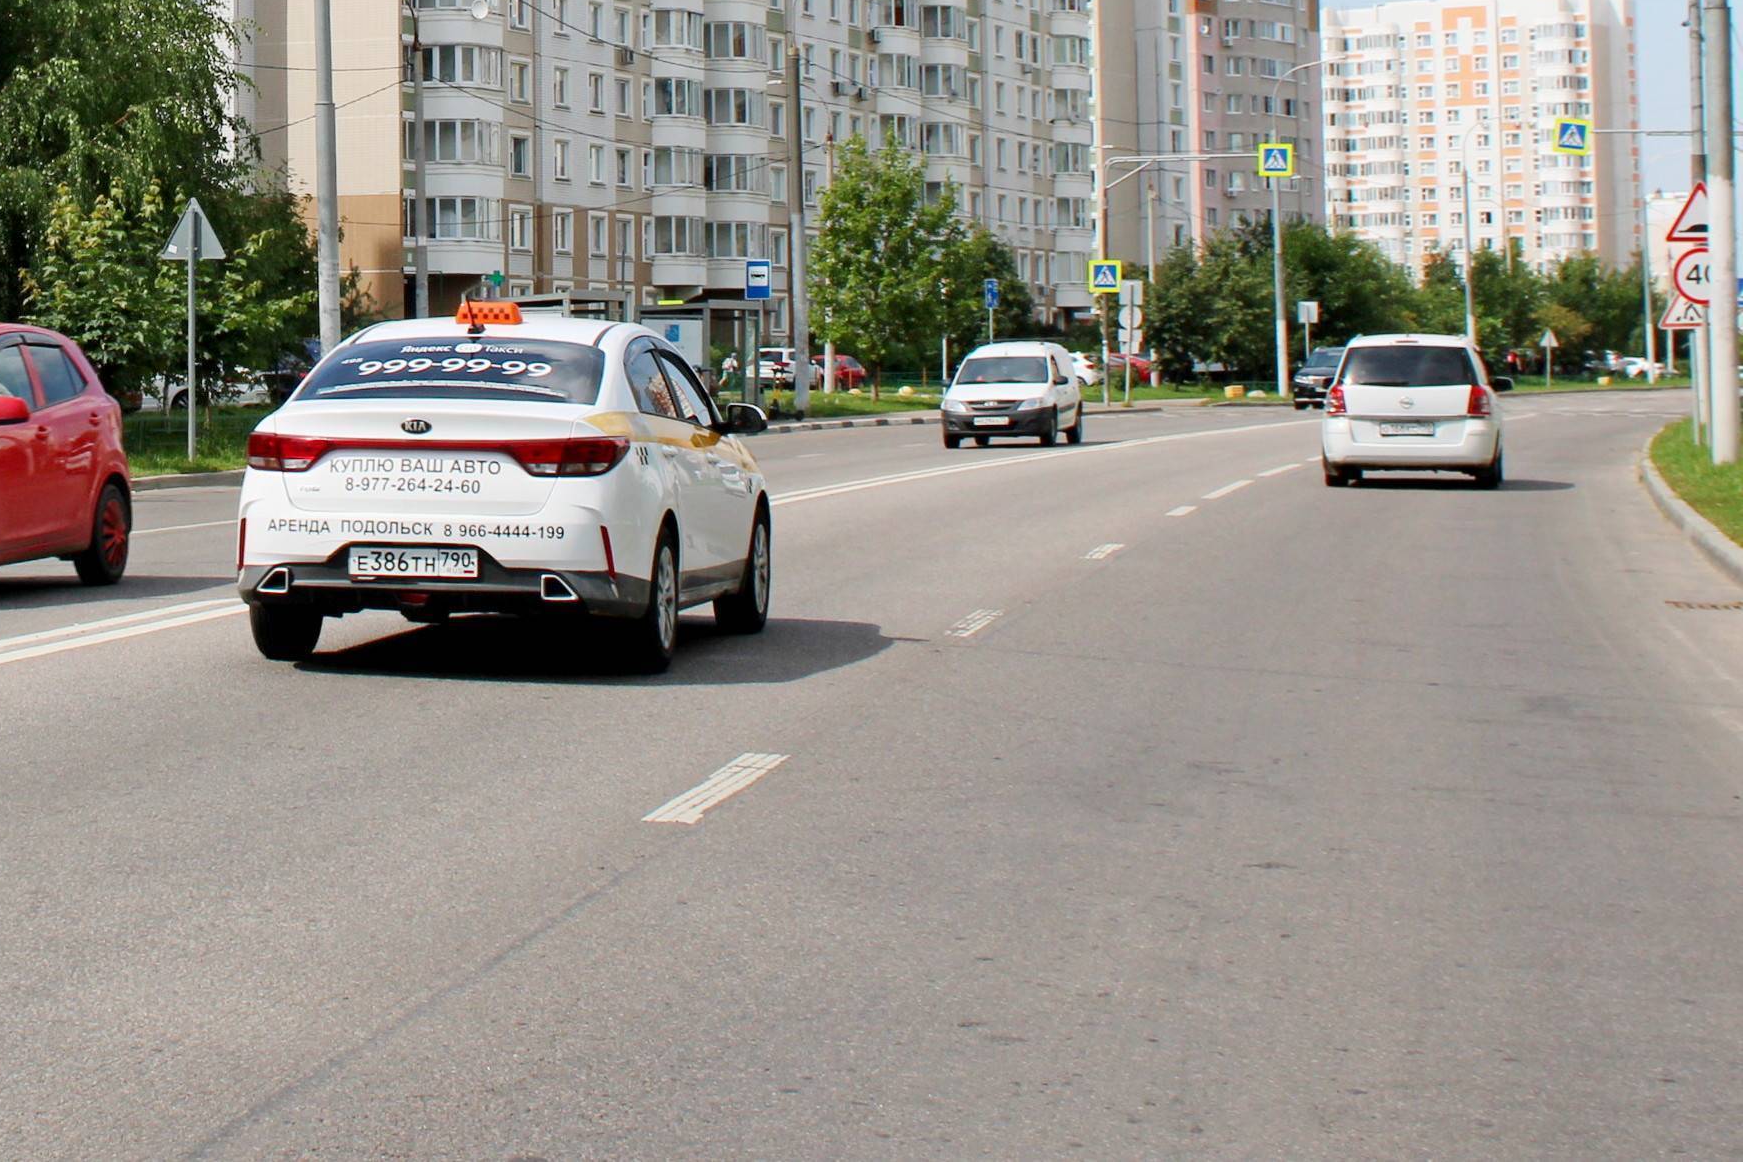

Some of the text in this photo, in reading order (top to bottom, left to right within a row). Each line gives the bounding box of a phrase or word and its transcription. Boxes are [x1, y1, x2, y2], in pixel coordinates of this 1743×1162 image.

[401, 345, 452, 353] Яндекс
[484, 345, 524, 354] Такси
[358, 357, 552, 377] 999-99-99
[404, 421, 427, 431] KIA
[330, 458, 501, 475] КУПЛЮ ВАШ АВТО
[345, 477, 480, 494] 8-977-264-24-60
[268, 519, 565, 539] АРЕНДА ПОДОЛЬСК 8 966-4444-199
[357, 551, 471, 572] Е386ТН 790
